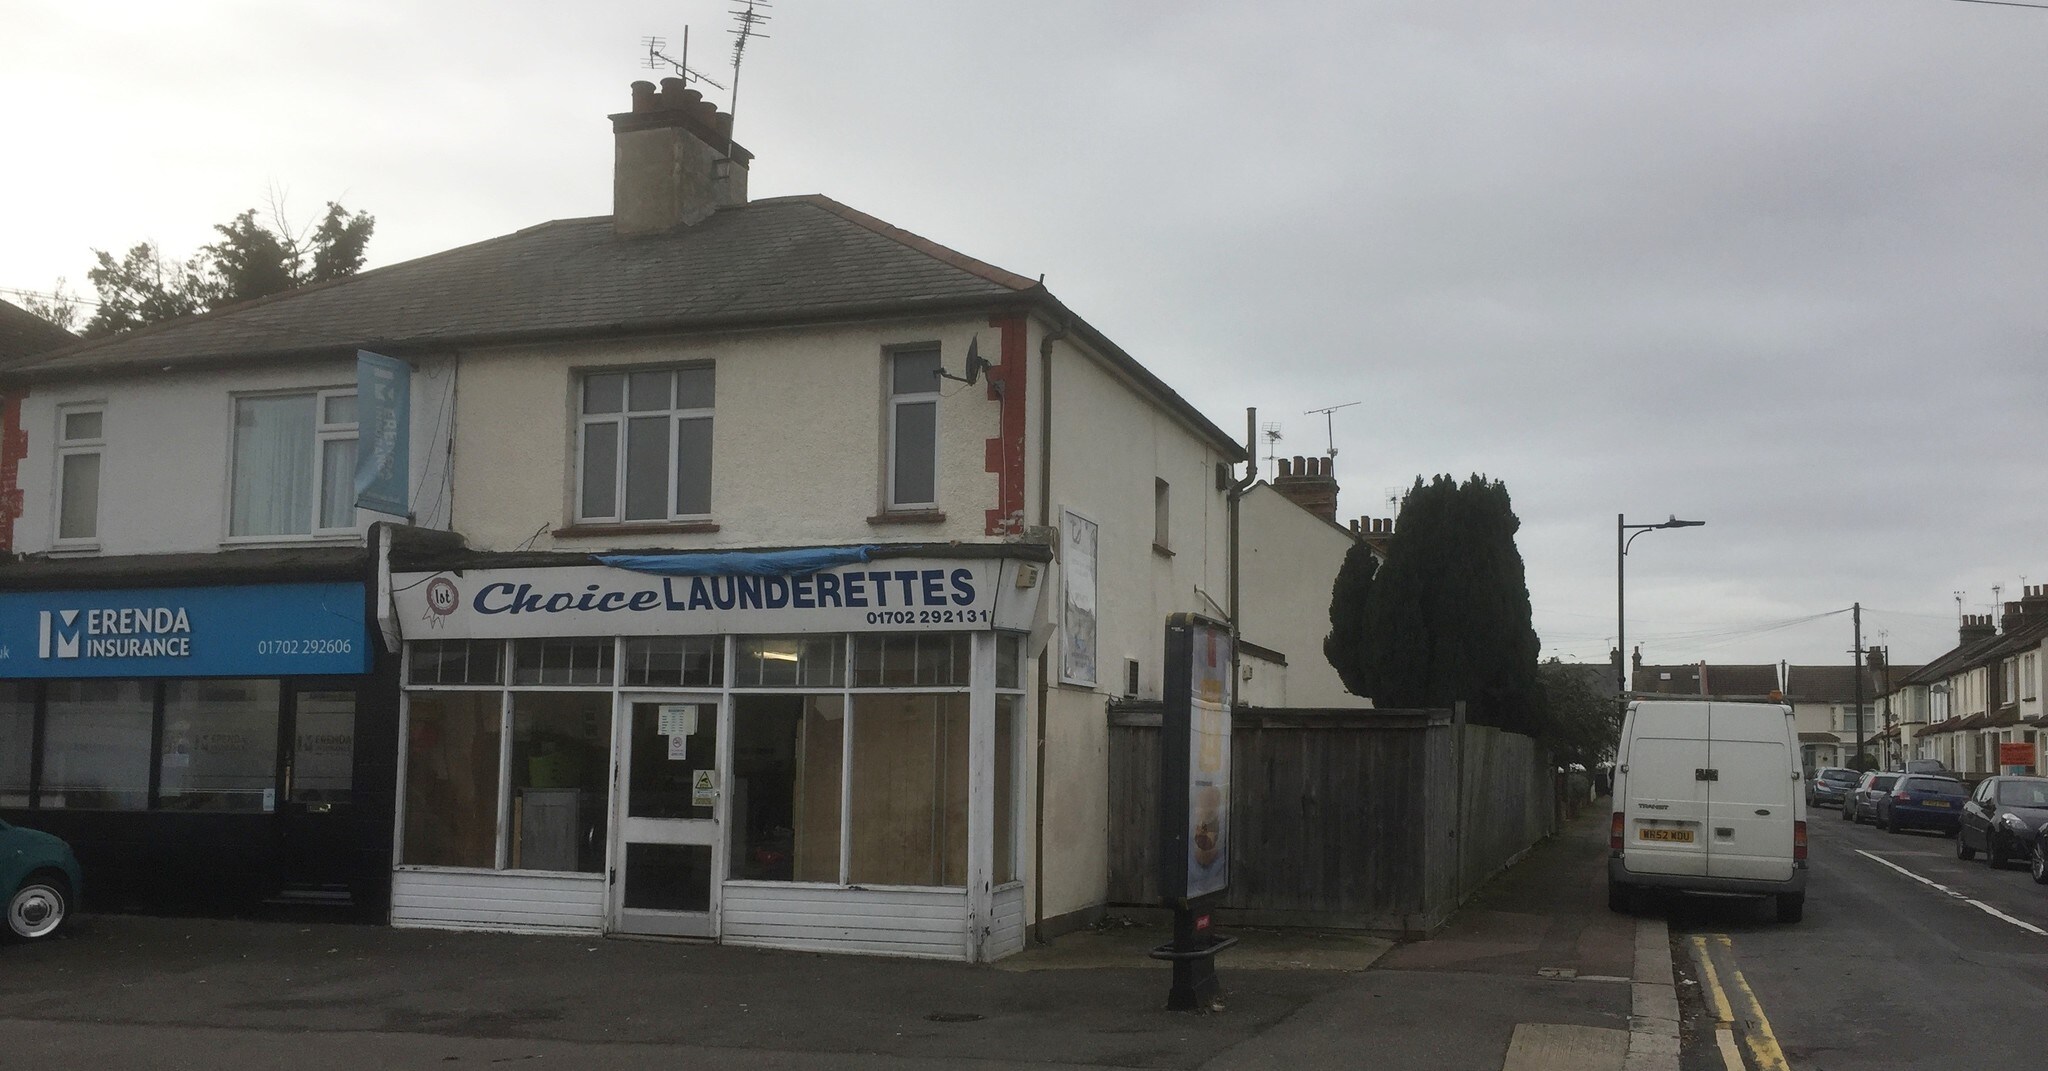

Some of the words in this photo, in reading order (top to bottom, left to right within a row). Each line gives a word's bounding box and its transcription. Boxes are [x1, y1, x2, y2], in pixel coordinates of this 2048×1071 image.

[472, 582, 662, 615] Choice
[663, 568, 976, 611] LAUNDERETTES
[866, 610, 916, 625] 01702
[919, 609, 988, 624] 292131
[87, 637, 190, 658] INSURANCE
[258, 640, 299, 655] 01702
[302, 639, 352, 654] 292606
